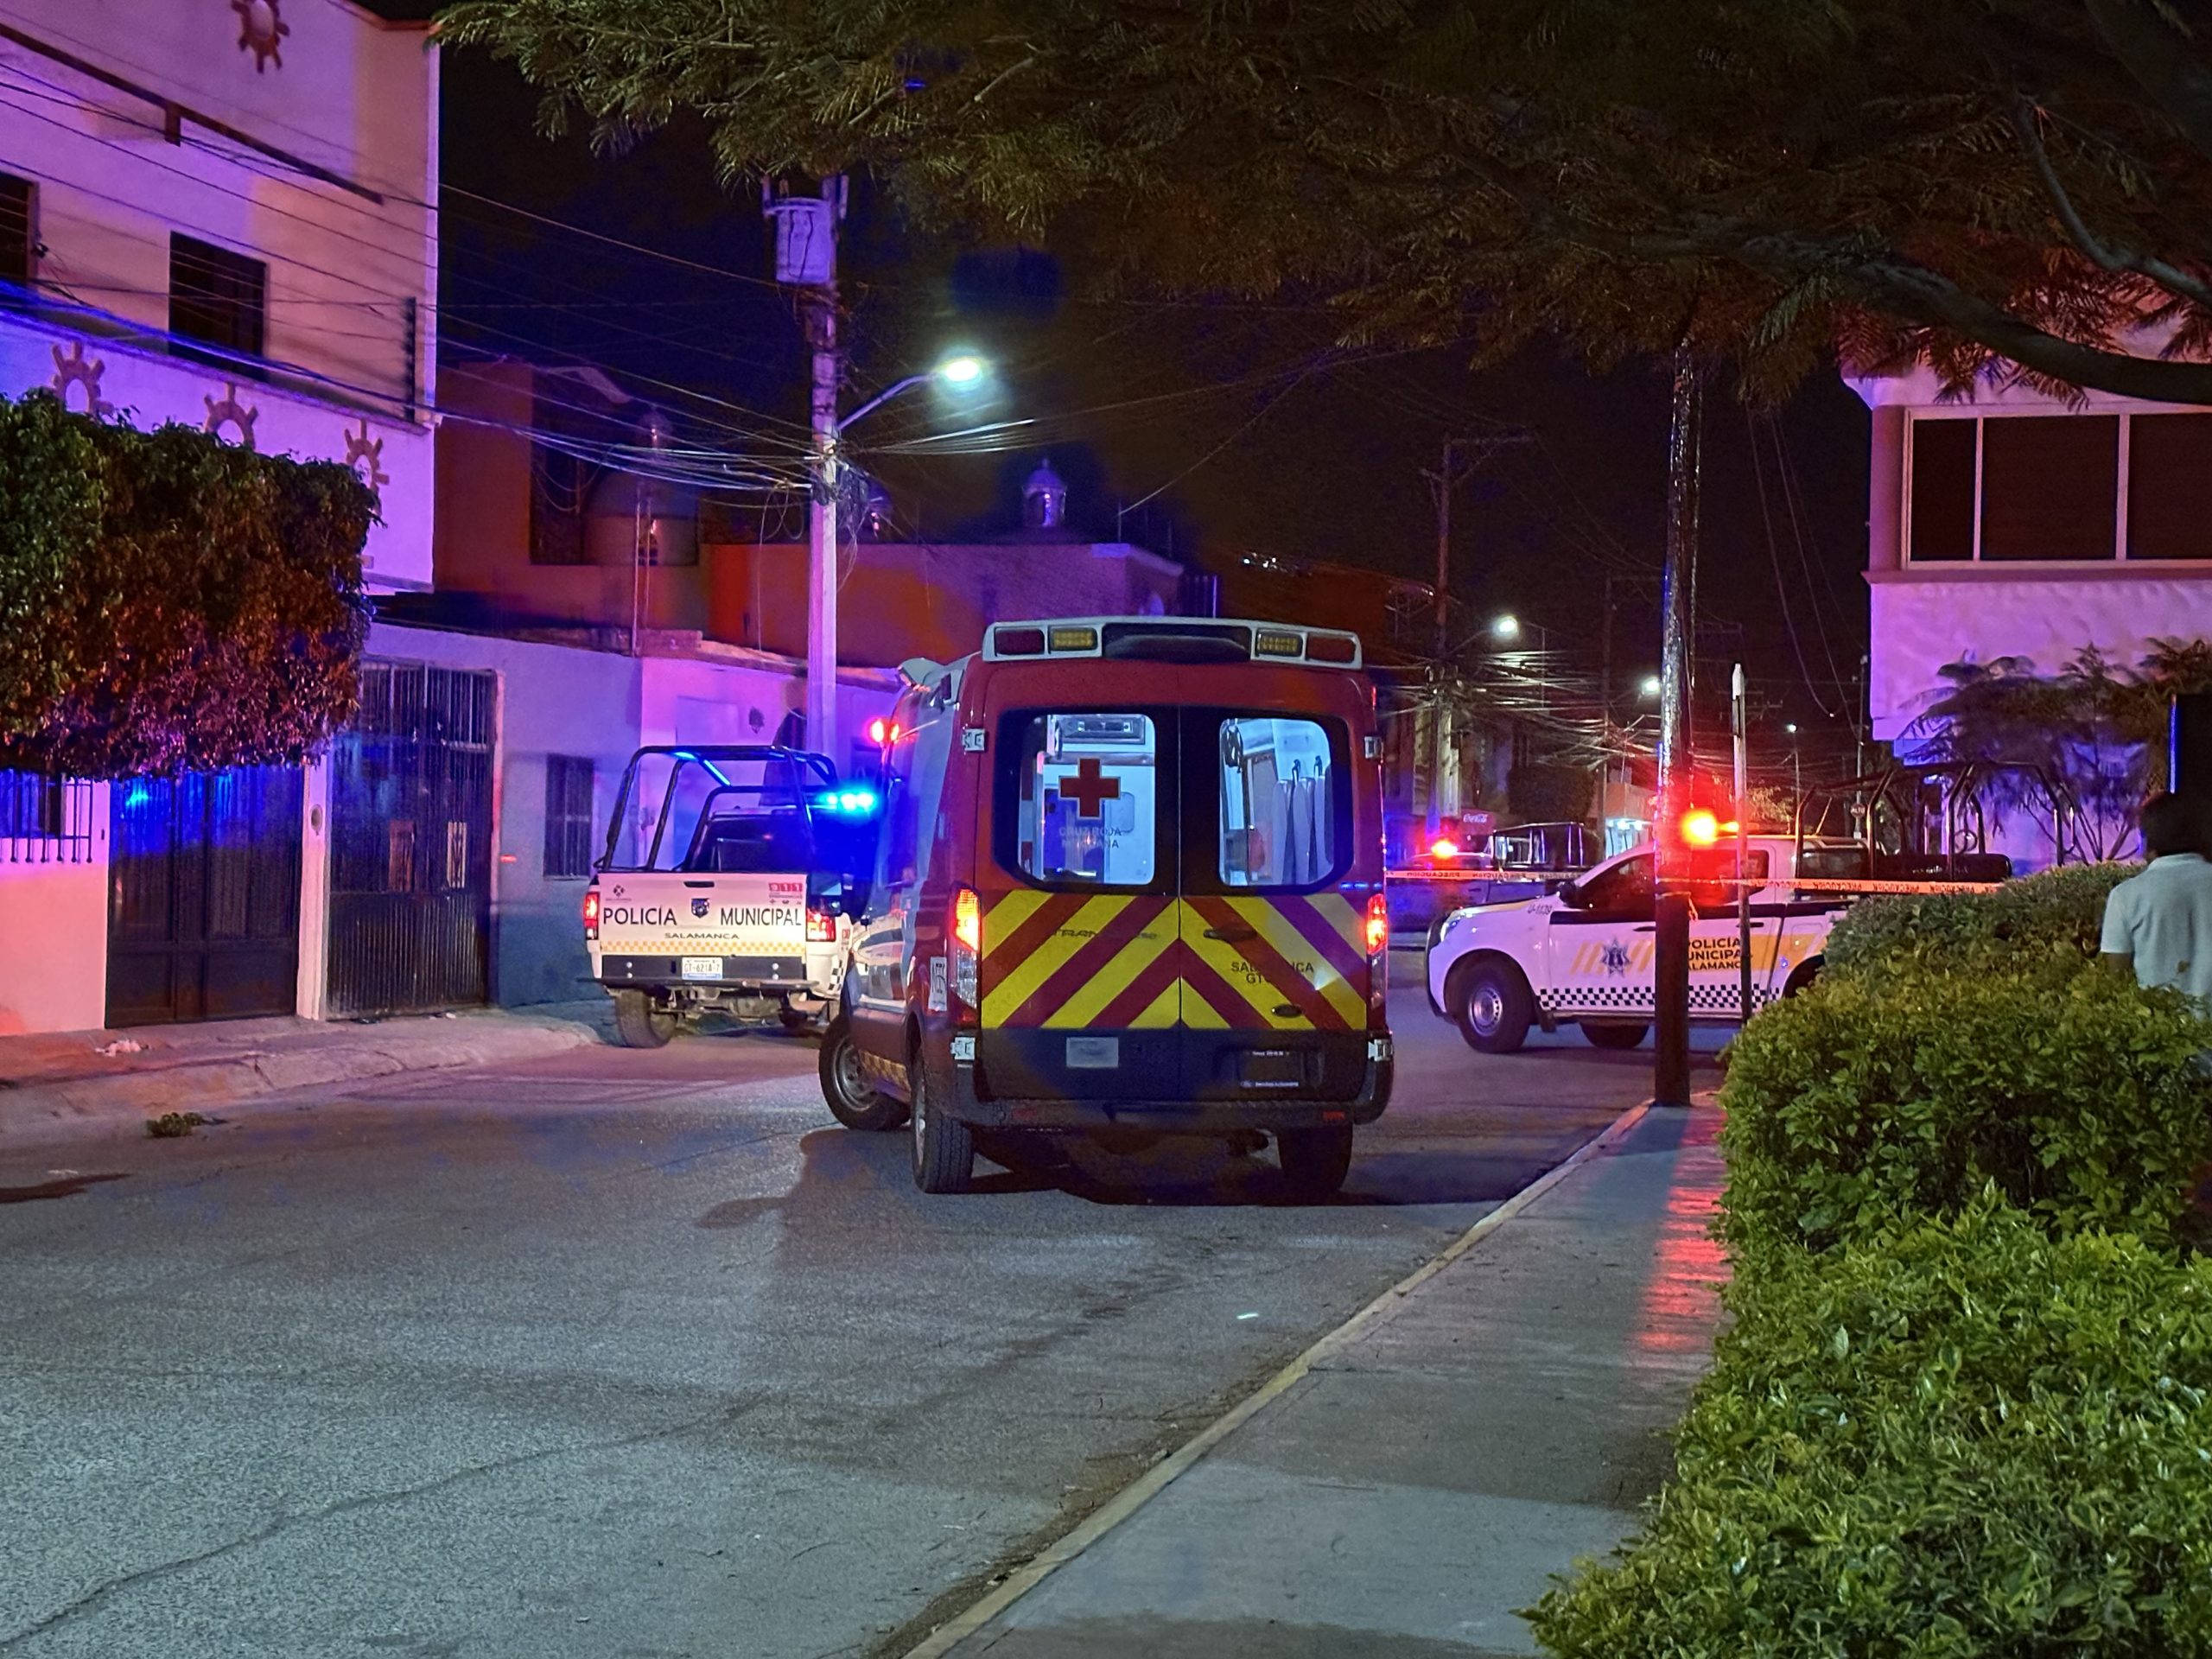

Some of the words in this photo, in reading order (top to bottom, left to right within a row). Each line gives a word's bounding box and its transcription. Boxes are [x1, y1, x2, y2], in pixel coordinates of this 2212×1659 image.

[603, 906, 677, 926] POLICÍA
[720, 907, 802, 927] MUNICIPAL
[1688, 937, 1740, 949] OLICÍA
[1688, 950, 1741, 961] UNICIPA
